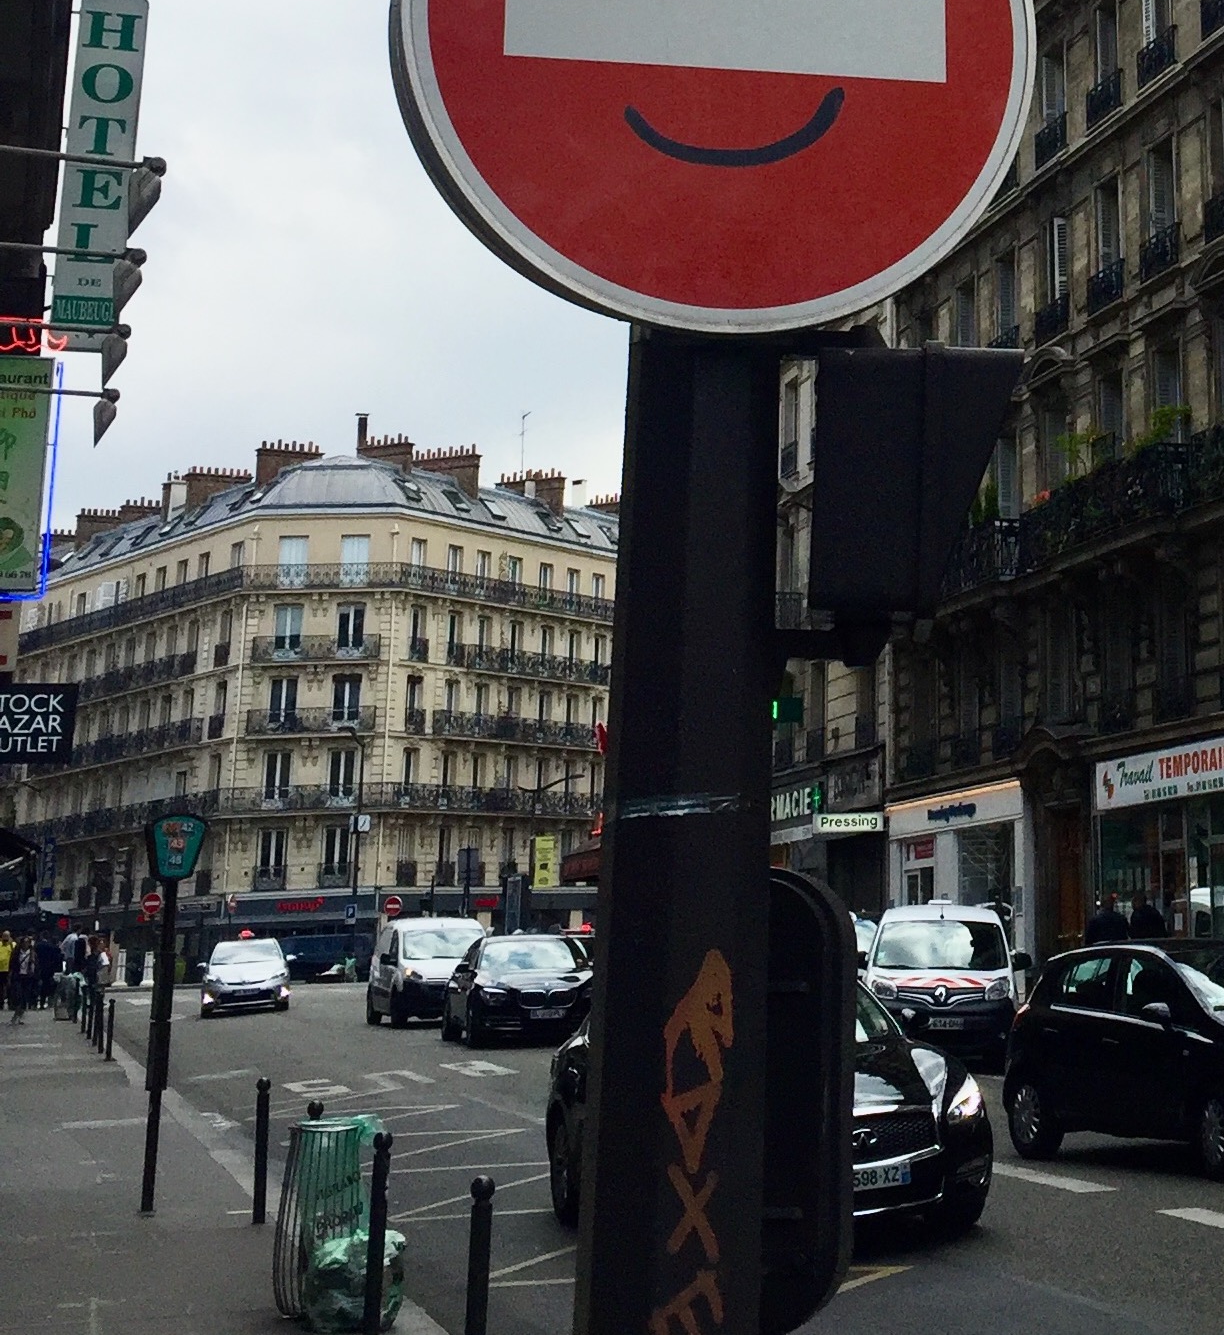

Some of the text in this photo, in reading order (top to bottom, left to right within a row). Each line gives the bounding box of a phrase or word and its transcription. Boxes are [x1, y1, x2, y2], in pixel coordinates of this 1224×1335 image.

[66, 10, 143, 264] HOTEL
[77, 277, 102, 287] DE
[1116, 760, 1155, 788] Travail
[821, 814, 878, 829] Pressing
